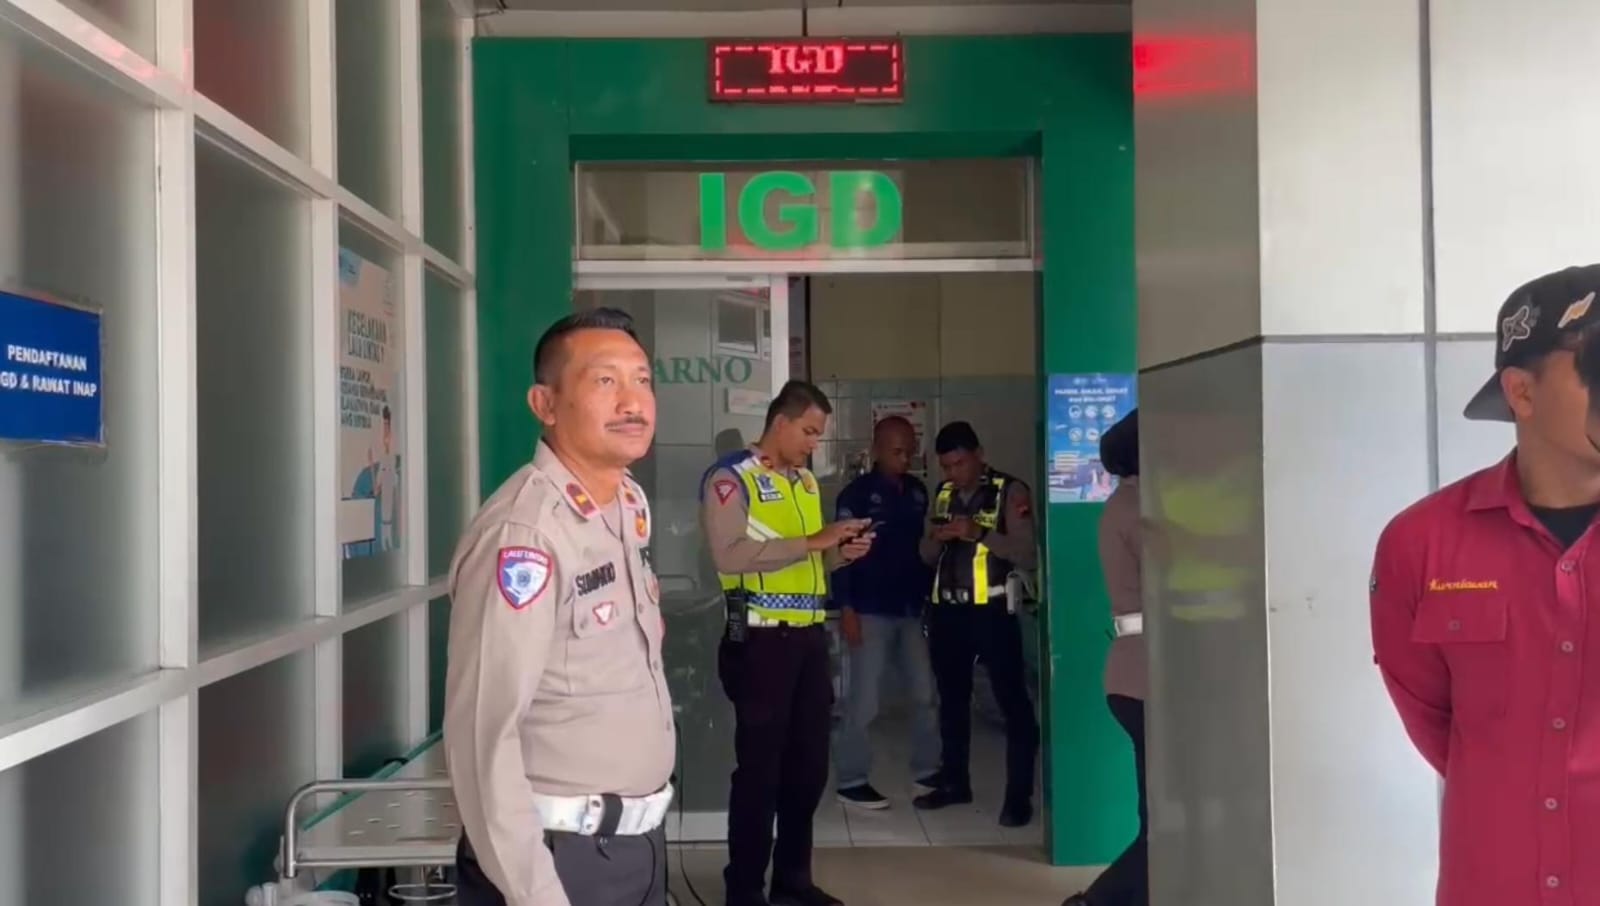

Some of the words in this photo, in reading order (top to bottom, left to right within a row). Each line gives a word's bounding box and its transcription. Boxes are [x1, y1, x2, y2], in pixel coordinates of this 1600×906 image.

[768, 44, 844, 74] IGD
[700, 170, 903, 251] IGD
[0, 371, 17, 389] GD
[20, 373, 29, 390] &
[32, 374, 71, 395] RAWAT
[73, 380, 97, 397] INAP
